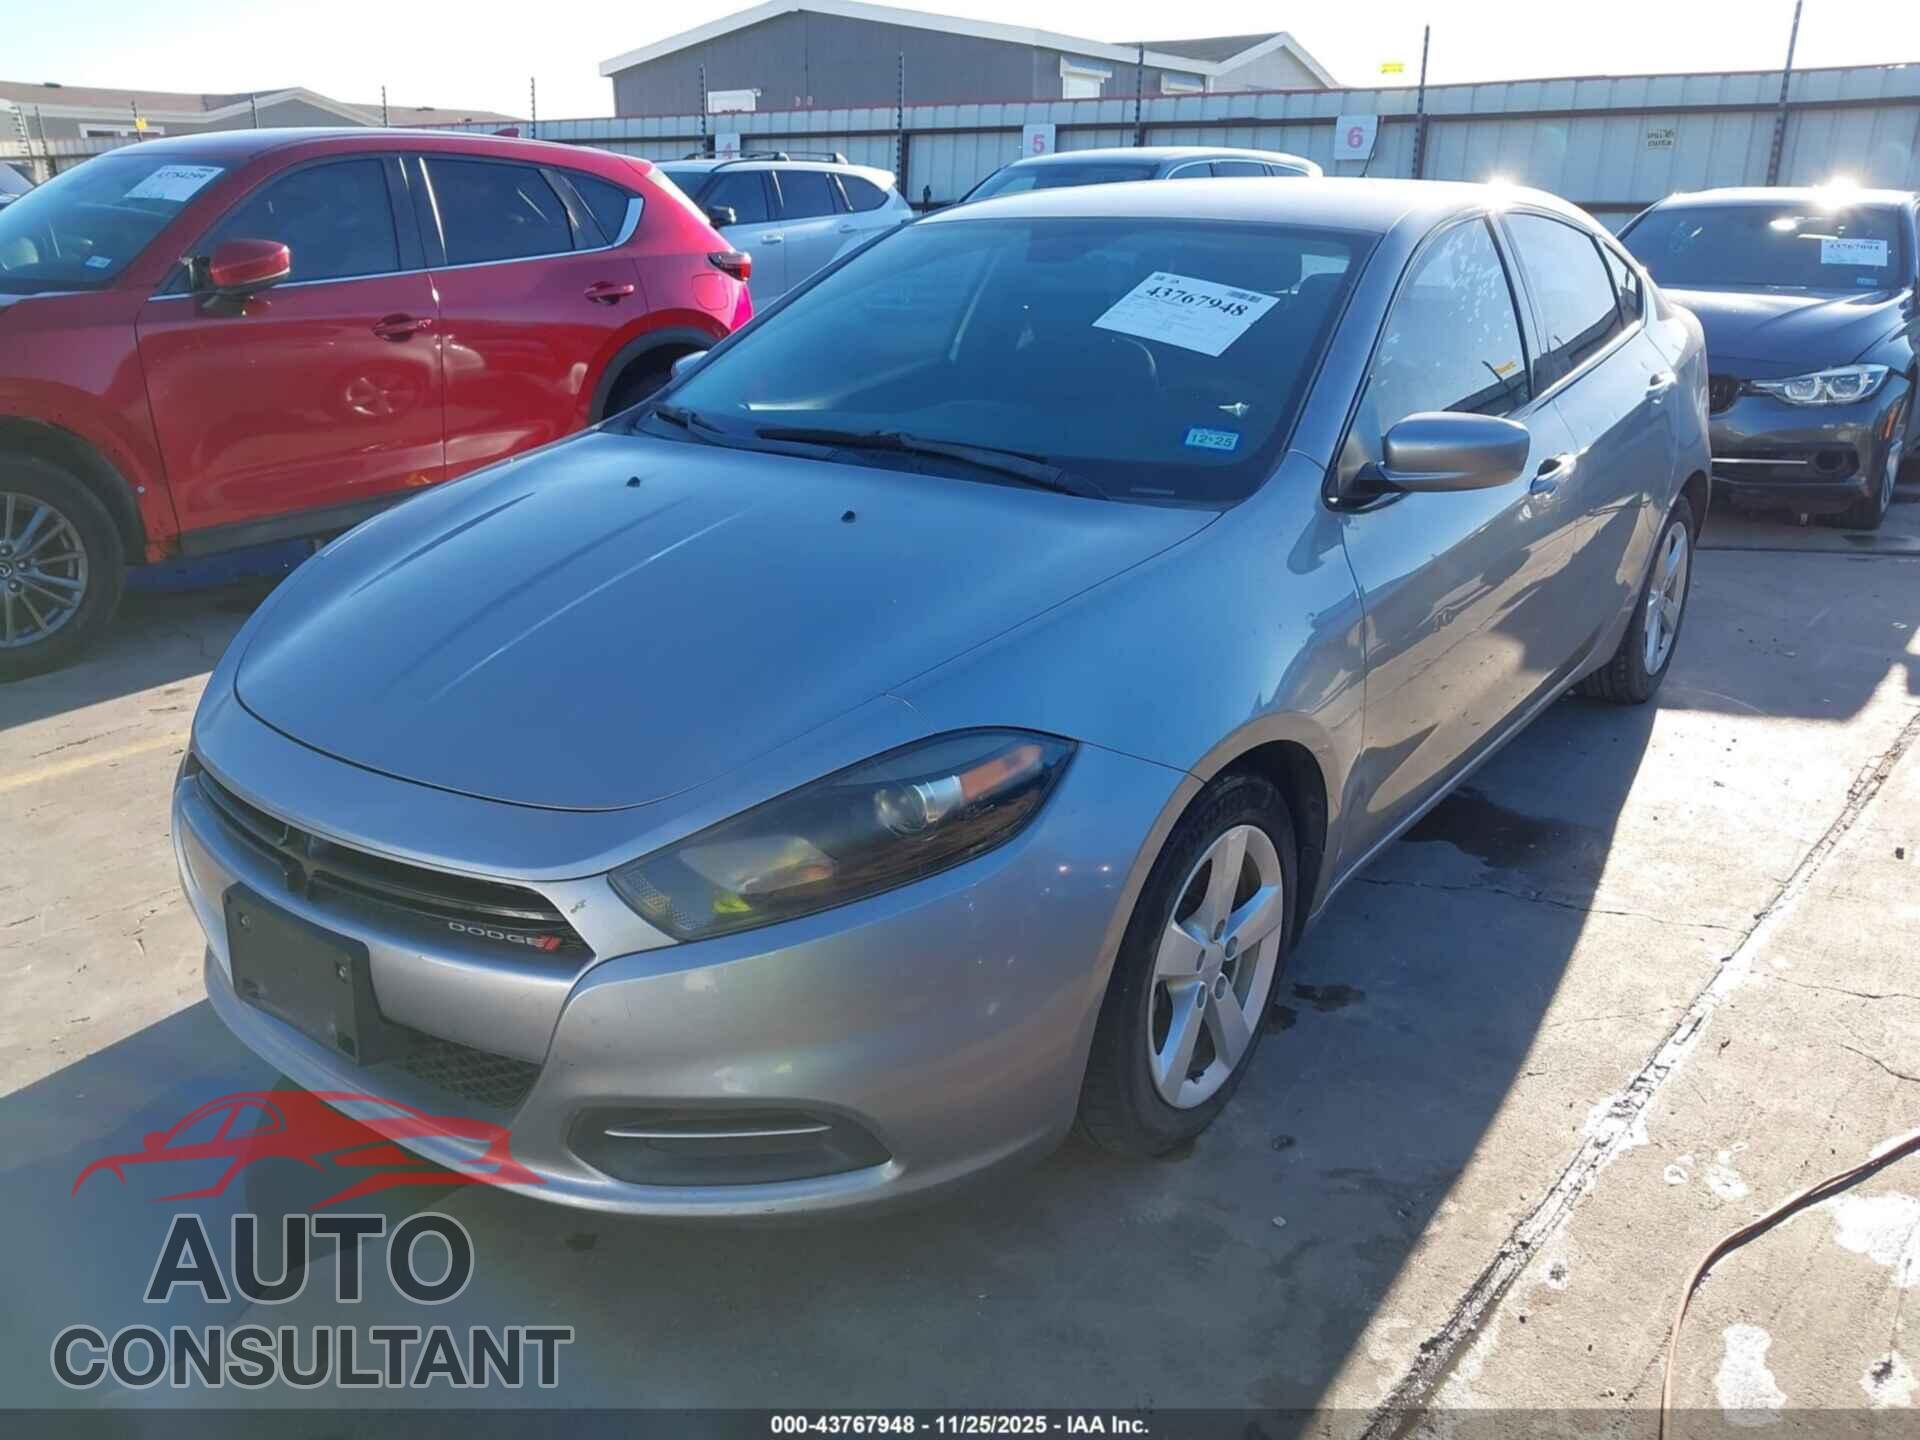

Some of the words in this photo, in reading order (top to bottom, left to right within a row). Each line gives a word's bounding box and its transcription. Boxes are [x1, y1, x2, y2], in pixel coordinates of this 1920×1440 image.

[1033, 133, 1045, 154] 5
[1347, 126, 1364, 149] 6
[1145, 286, 1249, 317] 43767948
[448, 922, 545, 948] DODGE
